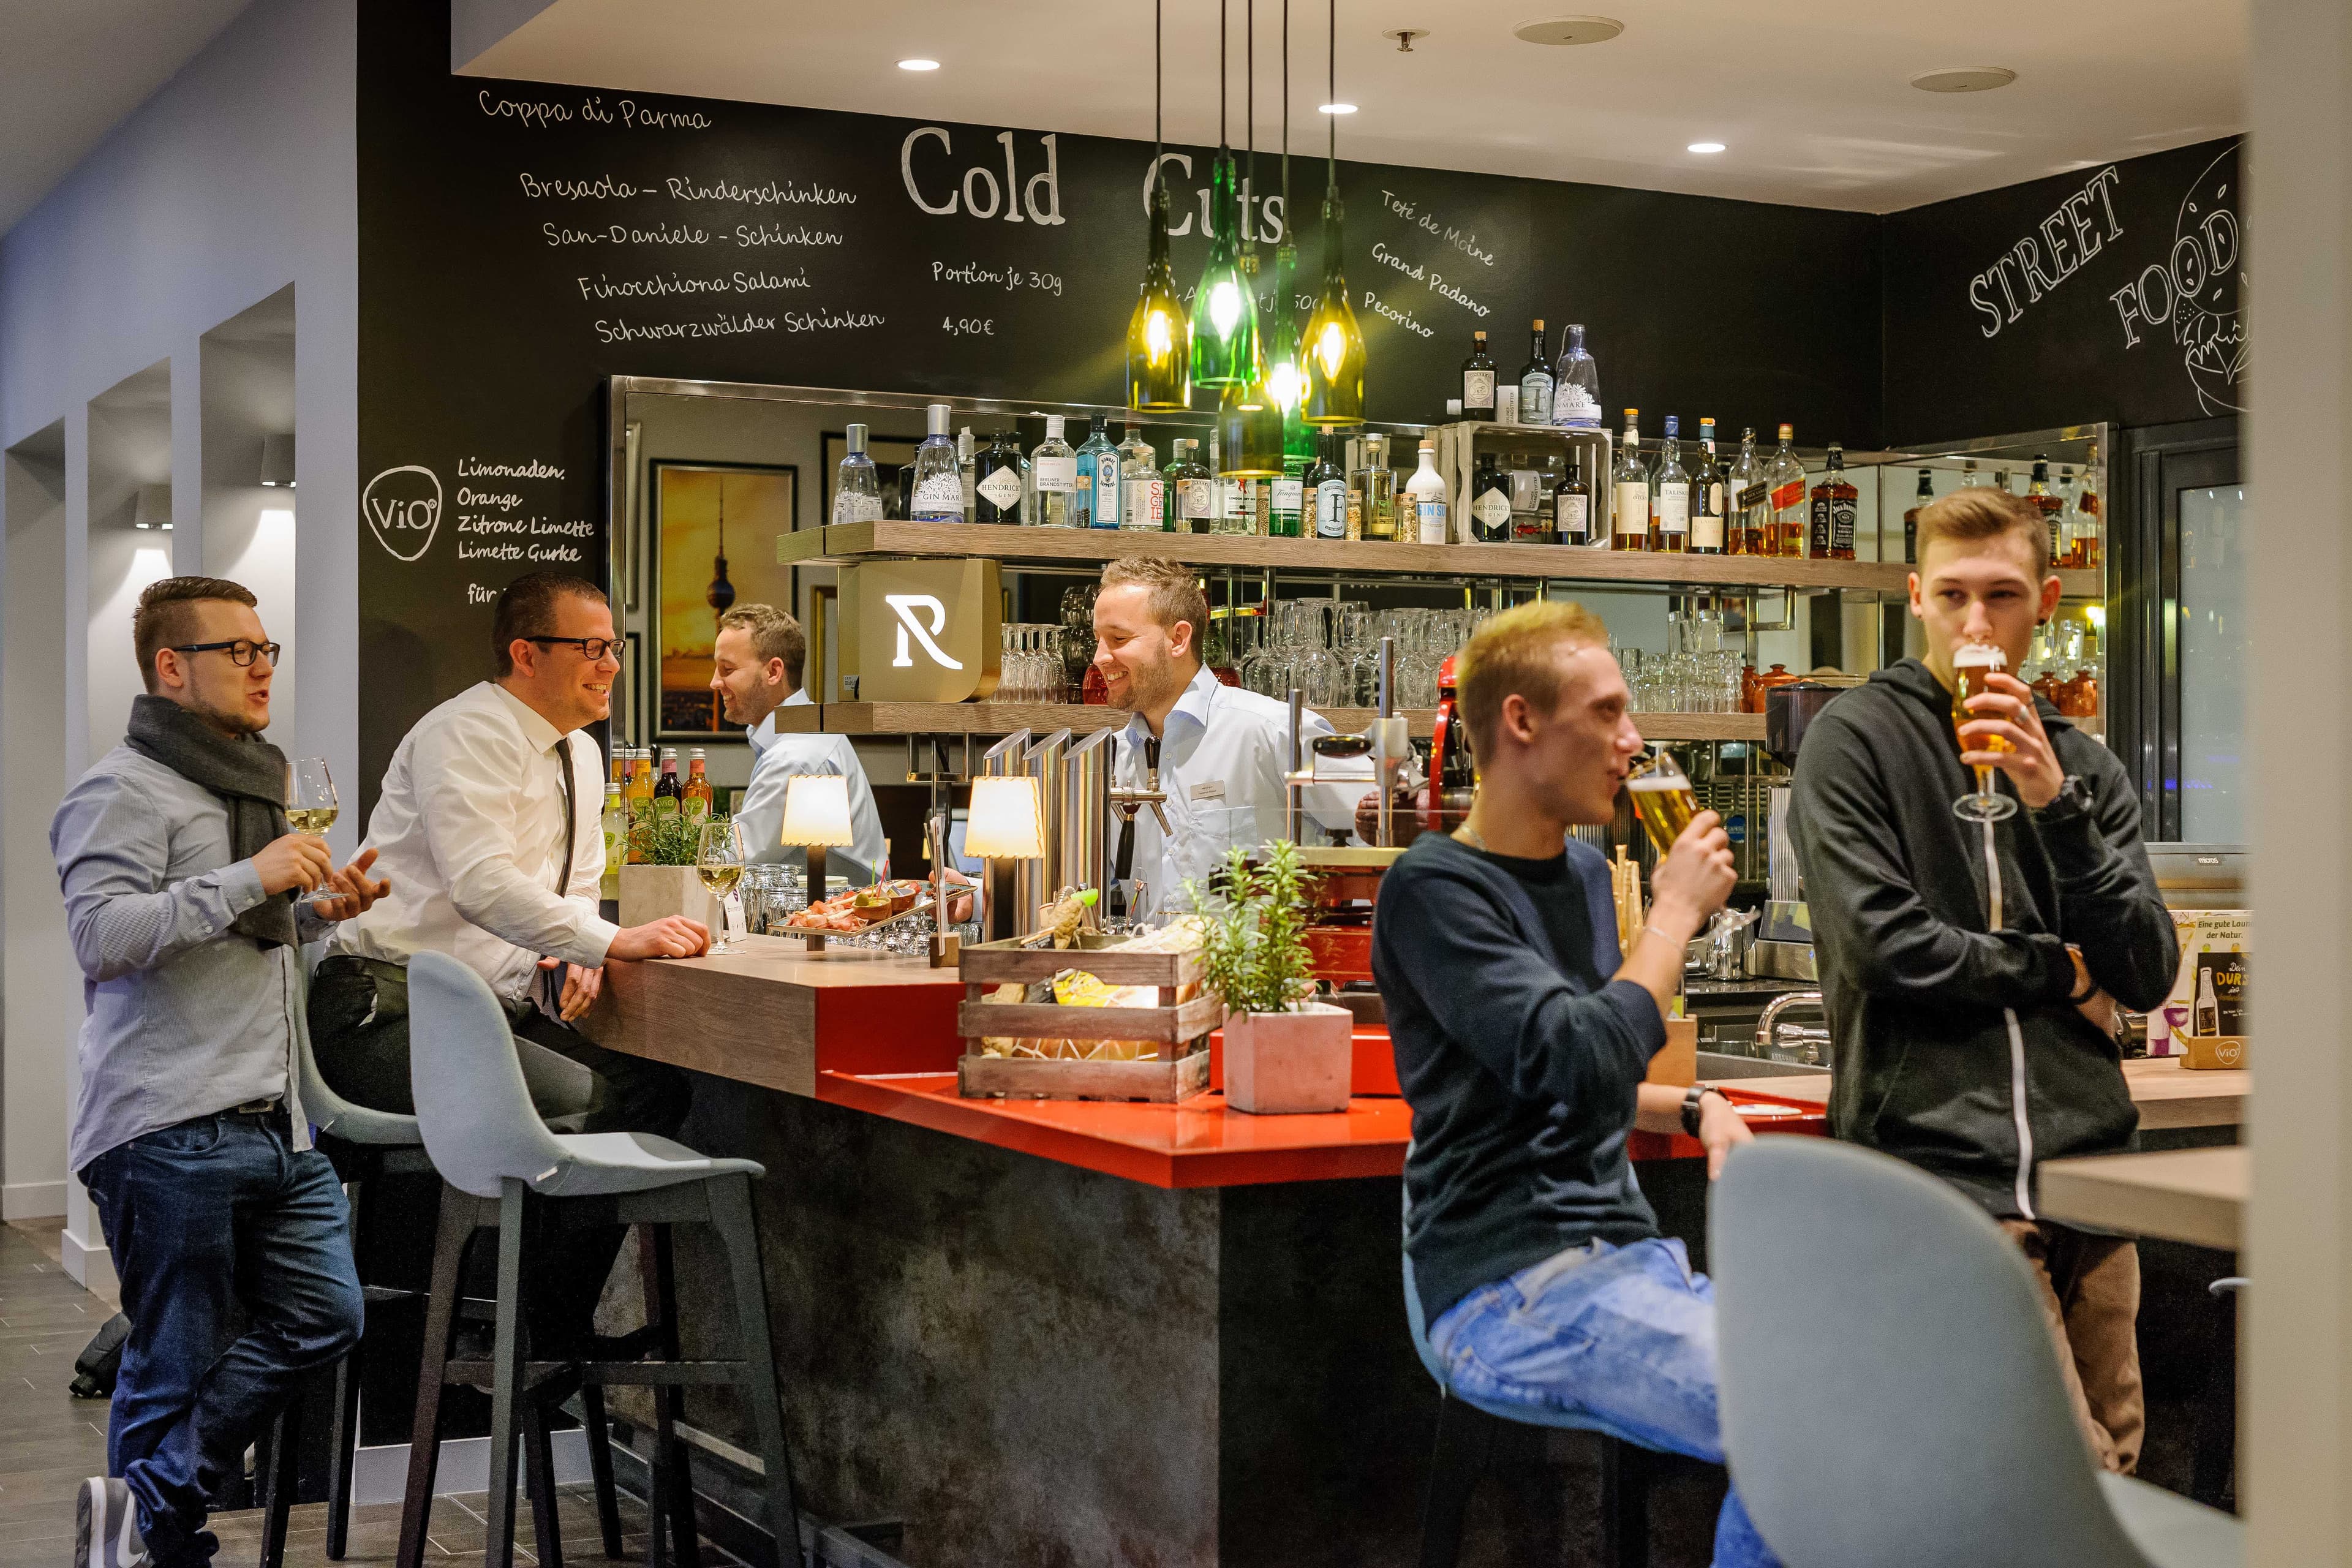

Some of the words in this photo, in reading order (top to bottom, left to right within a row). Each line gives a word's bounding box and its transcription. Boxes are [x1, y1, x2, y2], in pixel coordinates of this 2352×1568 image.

[479, 90, 573, 128] Coppa
[582, 96, 613, 124] di
[619, 99, 712, 129] Parma
[519, 173, 637, 200] Bresaola
[666, 176, 857, 205] Rinderschinken
[901, 127, 1066, 225] Cold
[543, 222, 709, 246] San-Daniele
[736, 222, 843, 247] Schinken
[1419, 214, 1441, 235] de
[1444, 226, 1494, 266] Moine
[1969, 165, 2124, 339] STREET
[577, 273, 730, 301] Finocchiona
[733, 266, 811, 293] Salami
[932, 261, 1003, 284] Portion
[1006, 266, 1024, 291] je
[1029, 271, 1062, 296] 30g
[1372, 243, 1425, 281] Grand
[1428, 273, 1490, 317] Padano
[2109, 209, 2239, 349] FOOD
[595, 312, 775, 343] Schwarzwälder
[784, 307, 885, 333] Schinken
[942, 316, 995, 336] 4,90€
[1364, 292, 1434, 337] Pecorino
[457, 487, 523, 511] Orange
[458, 514, 528, 534] Zitrone
[530, 516, 594, 537] Limette
[458, 540, 524, 560] Limette
[527, 543, 582, 562] Gurke
[467, 582, 497, 605] für
[885, 594, 963, 670] R
[2214, 921, 2231, 930] gute
